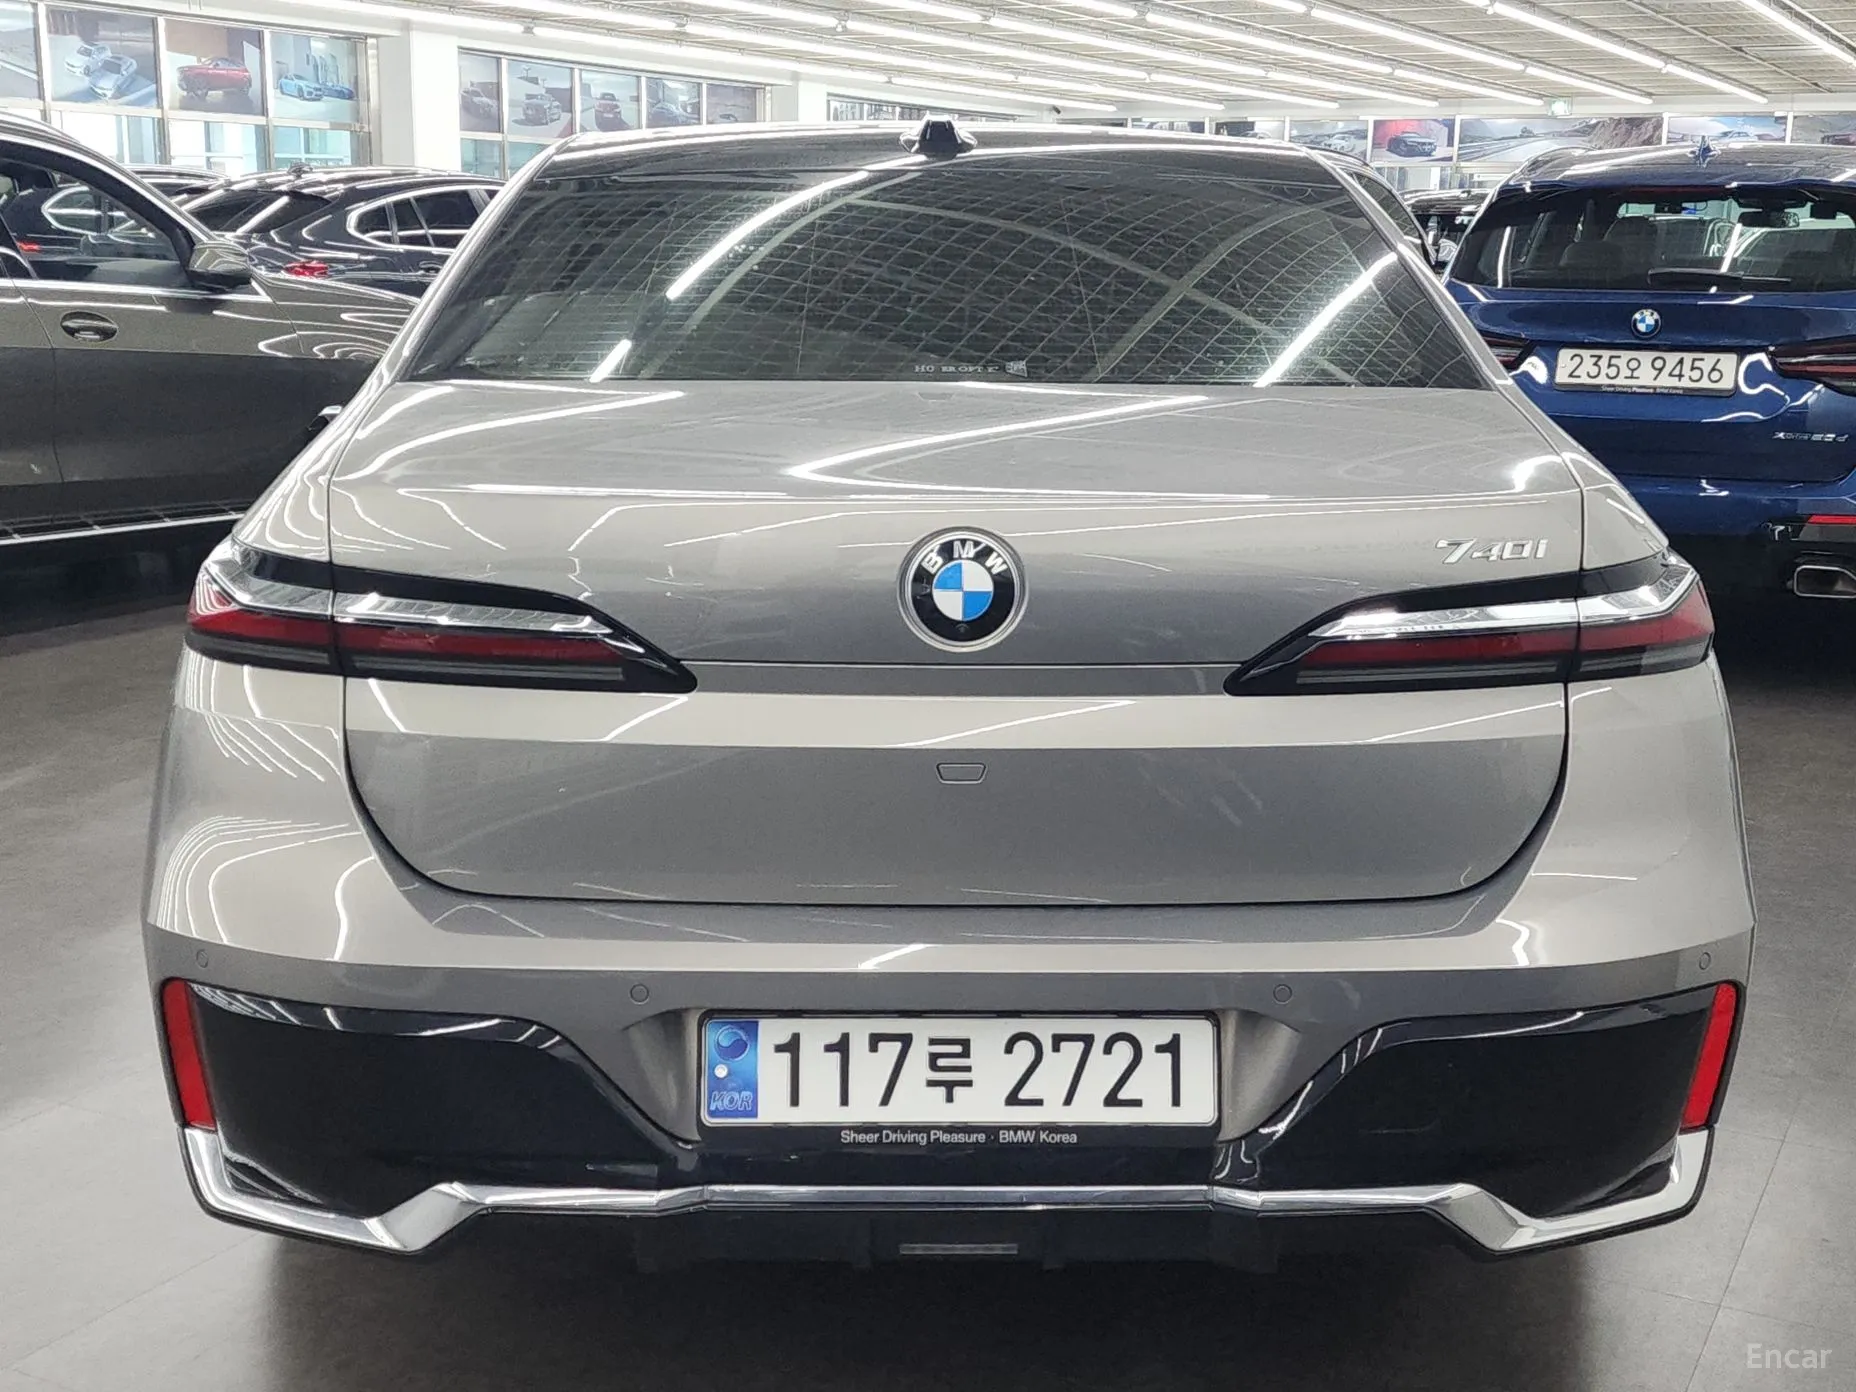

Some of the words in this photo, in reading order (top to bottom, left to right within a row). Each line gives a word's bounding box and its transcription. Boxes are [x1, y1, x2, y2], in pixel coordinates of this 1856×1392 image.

[1568, 353, 1642, 380] 235오
[1651, 355, 1724, 384] 9456
[921, 540, 1008, 575] BMW
[1435, 538, 1548, 564] 740i
[774, 1031, 974, 1108] 117루
[1003, 1031, 1181, 1108] 2721
[709, 1091, 753, 1111] KOR
[840, 1130, 880, 1144] Sheer
[882, 1130, 928, 1146] Driving
[929, 1130, 986, 1144] Pleasure
[999, 1130, 1036, 1144] BMW
[1039, 1130, 1078, 1144] Korea
